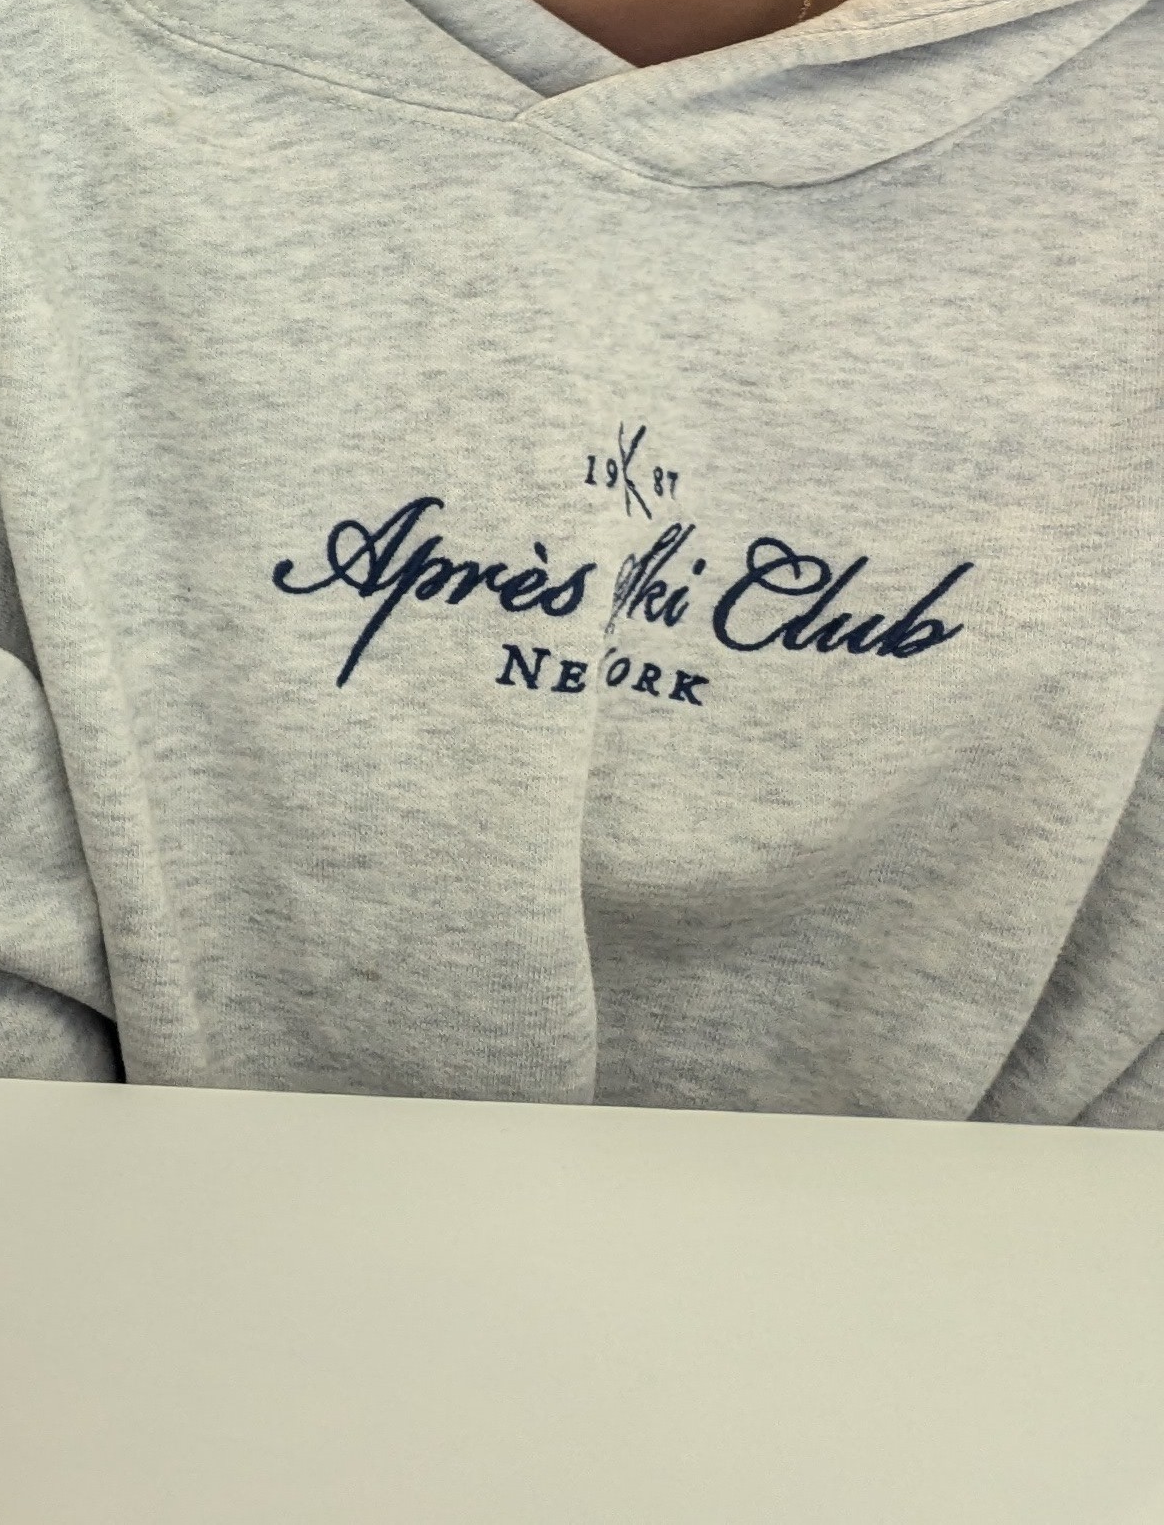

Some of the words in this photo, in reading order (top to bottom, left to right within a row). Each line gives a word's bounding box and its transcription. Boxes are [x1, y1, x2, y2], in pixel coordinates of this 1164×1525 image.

[584, 455, 618, 488] 19
[653, 466, 678, 500] 87
[273, 496, 597, 688] Après
[712, 536, 974, 659] Club
[495, 643, 588, 693] NE
[598, 647, 710, 706] ORK
